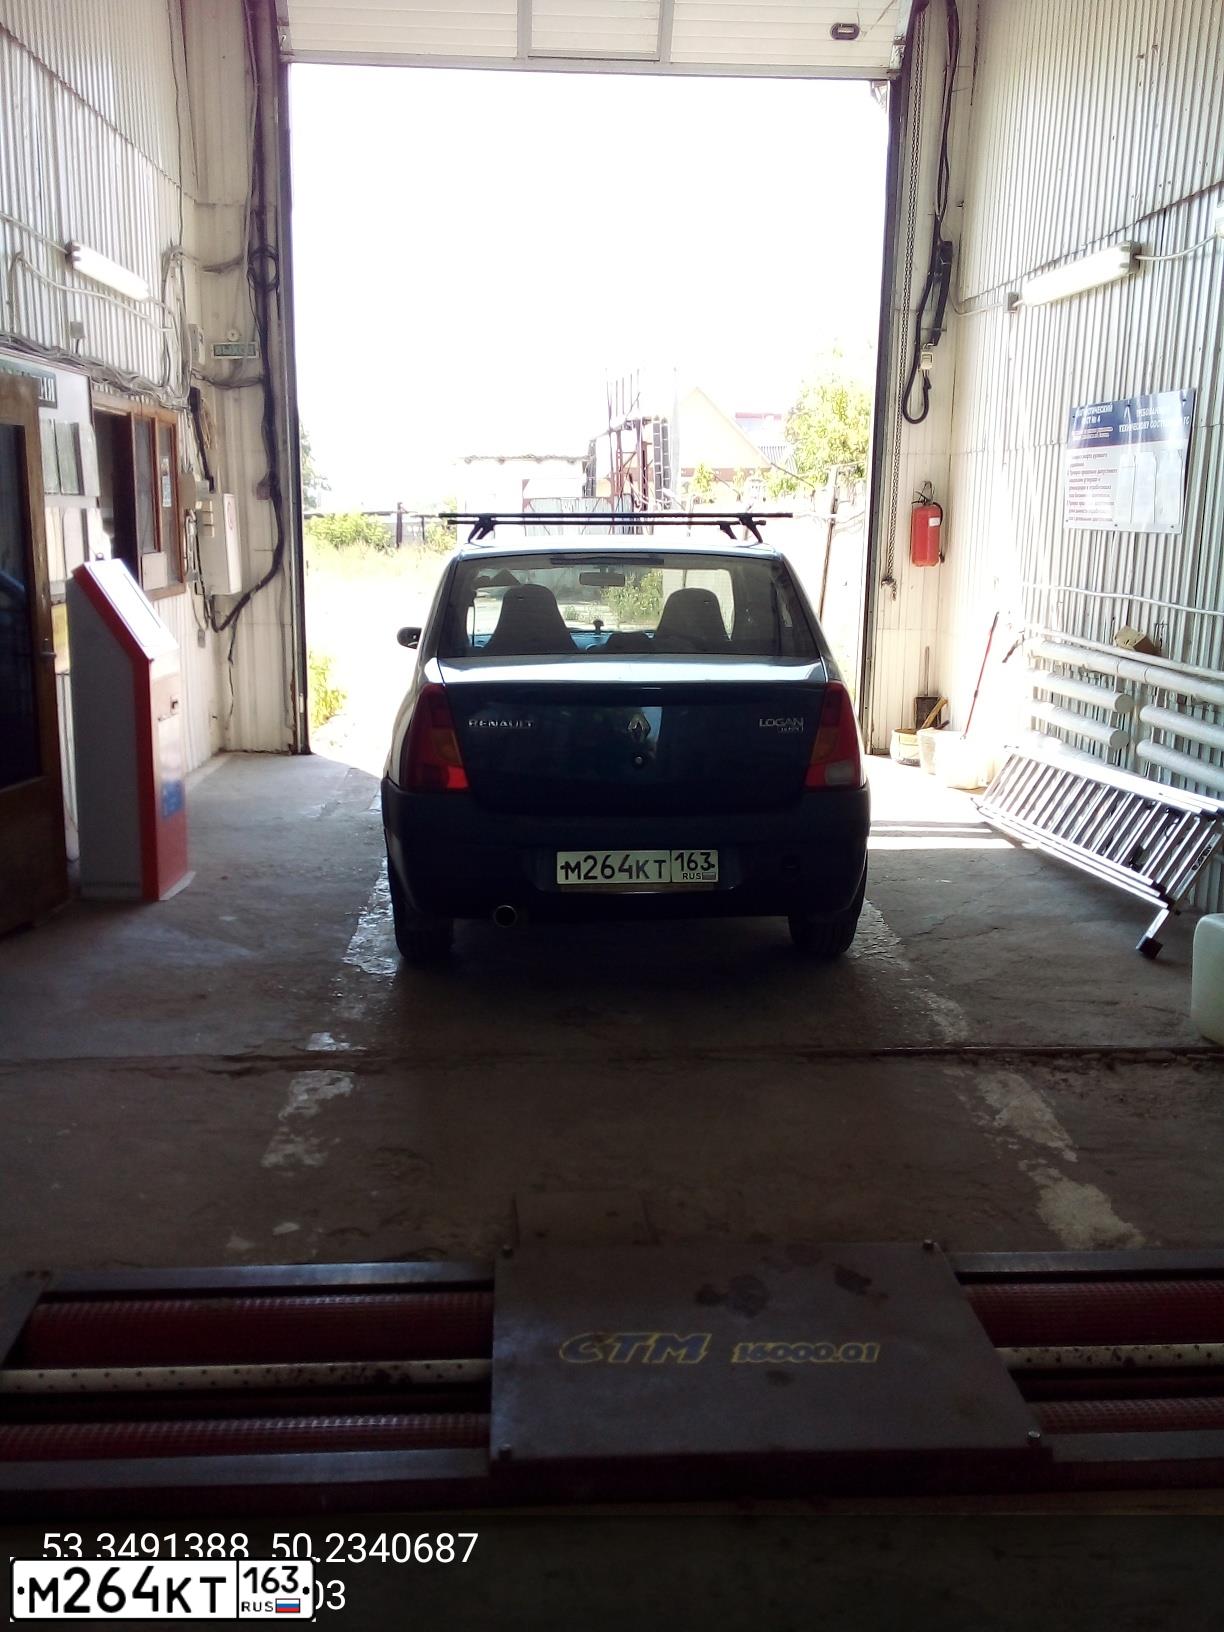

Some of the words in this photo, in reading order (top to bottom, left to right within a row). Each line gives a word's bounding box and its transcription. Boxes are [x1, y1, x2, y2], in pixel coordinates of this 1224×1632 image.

[468, 719, 534, 729] RENAULT
[759, 718, 804, 728] LOGAN
[674, 852, 711, 872] 163
[682, 872, 702, 880] RUS
